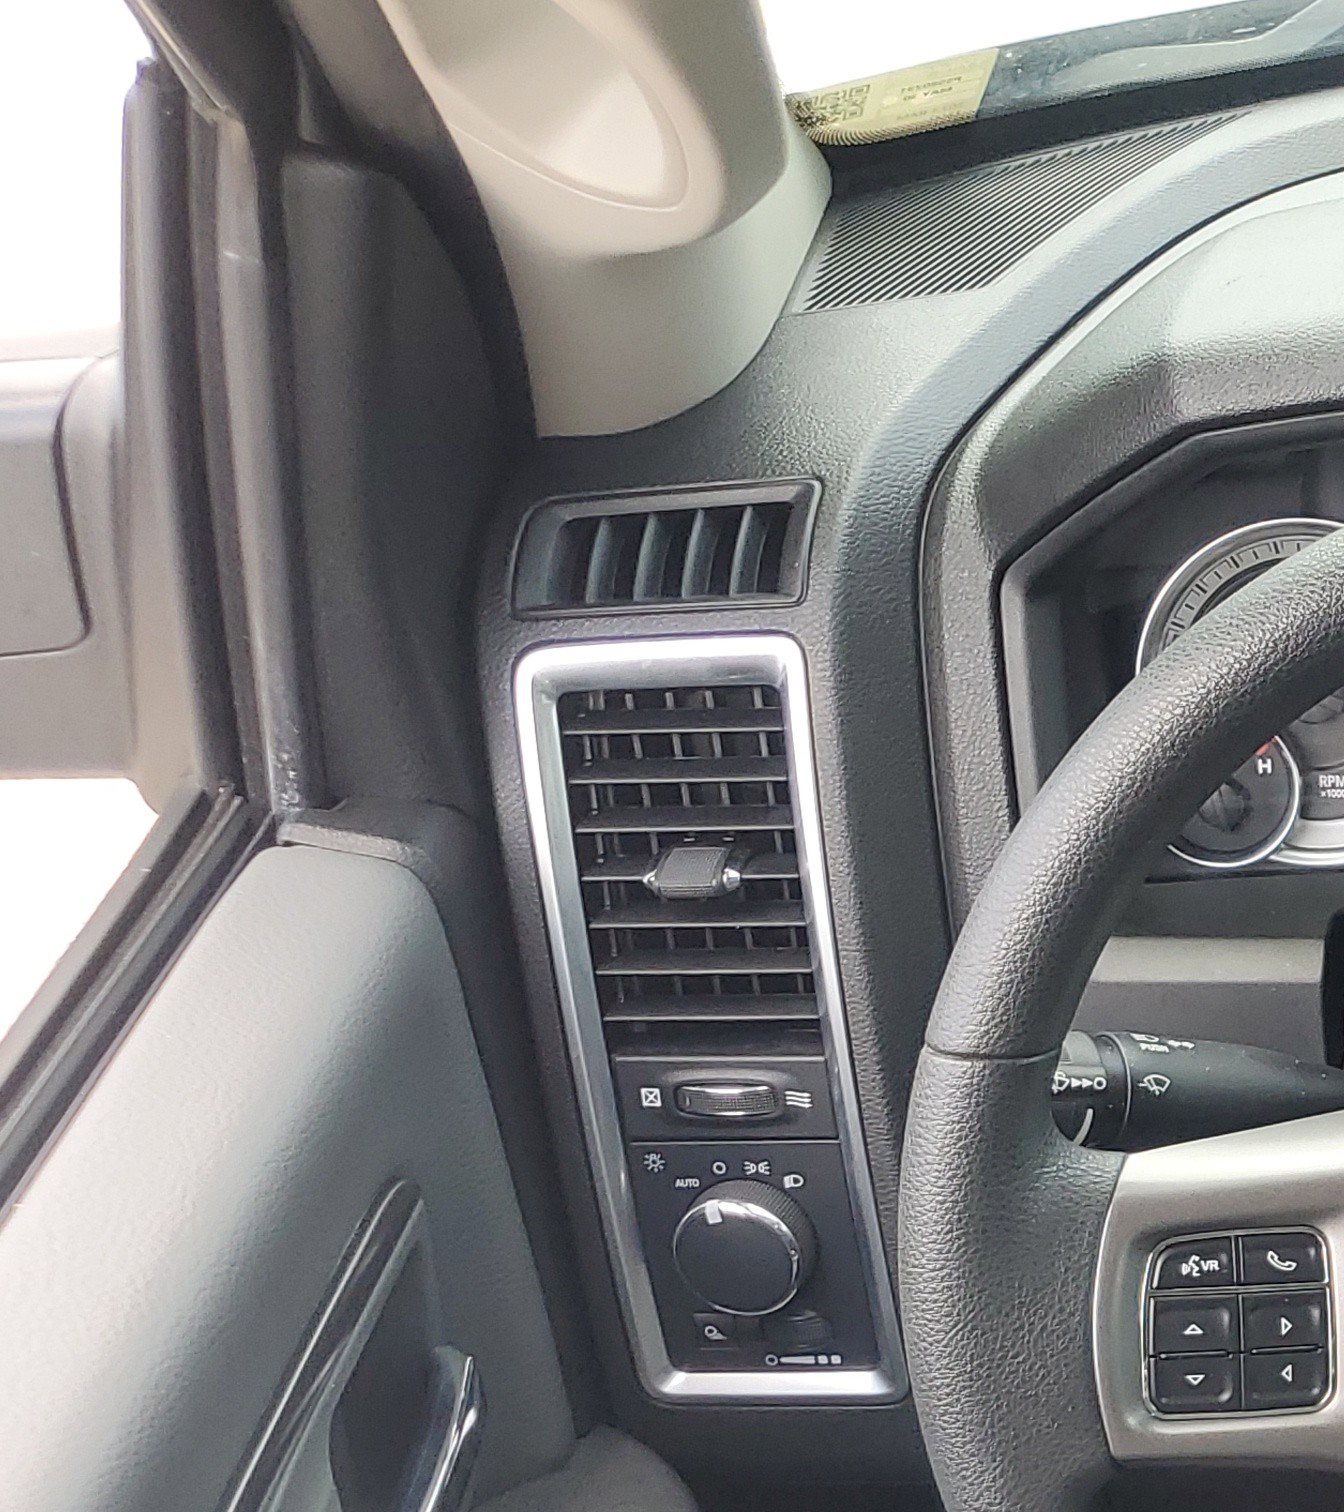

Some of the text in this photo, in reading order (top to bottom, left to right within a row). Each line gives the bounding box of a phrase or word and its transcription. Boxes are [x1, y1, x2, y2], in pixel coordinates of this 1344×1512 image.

[1257, 758, 1272, 774] H
[675, 1176, 700, 1188] AUTO
[1201, 1259, 1220, 1272] VR
